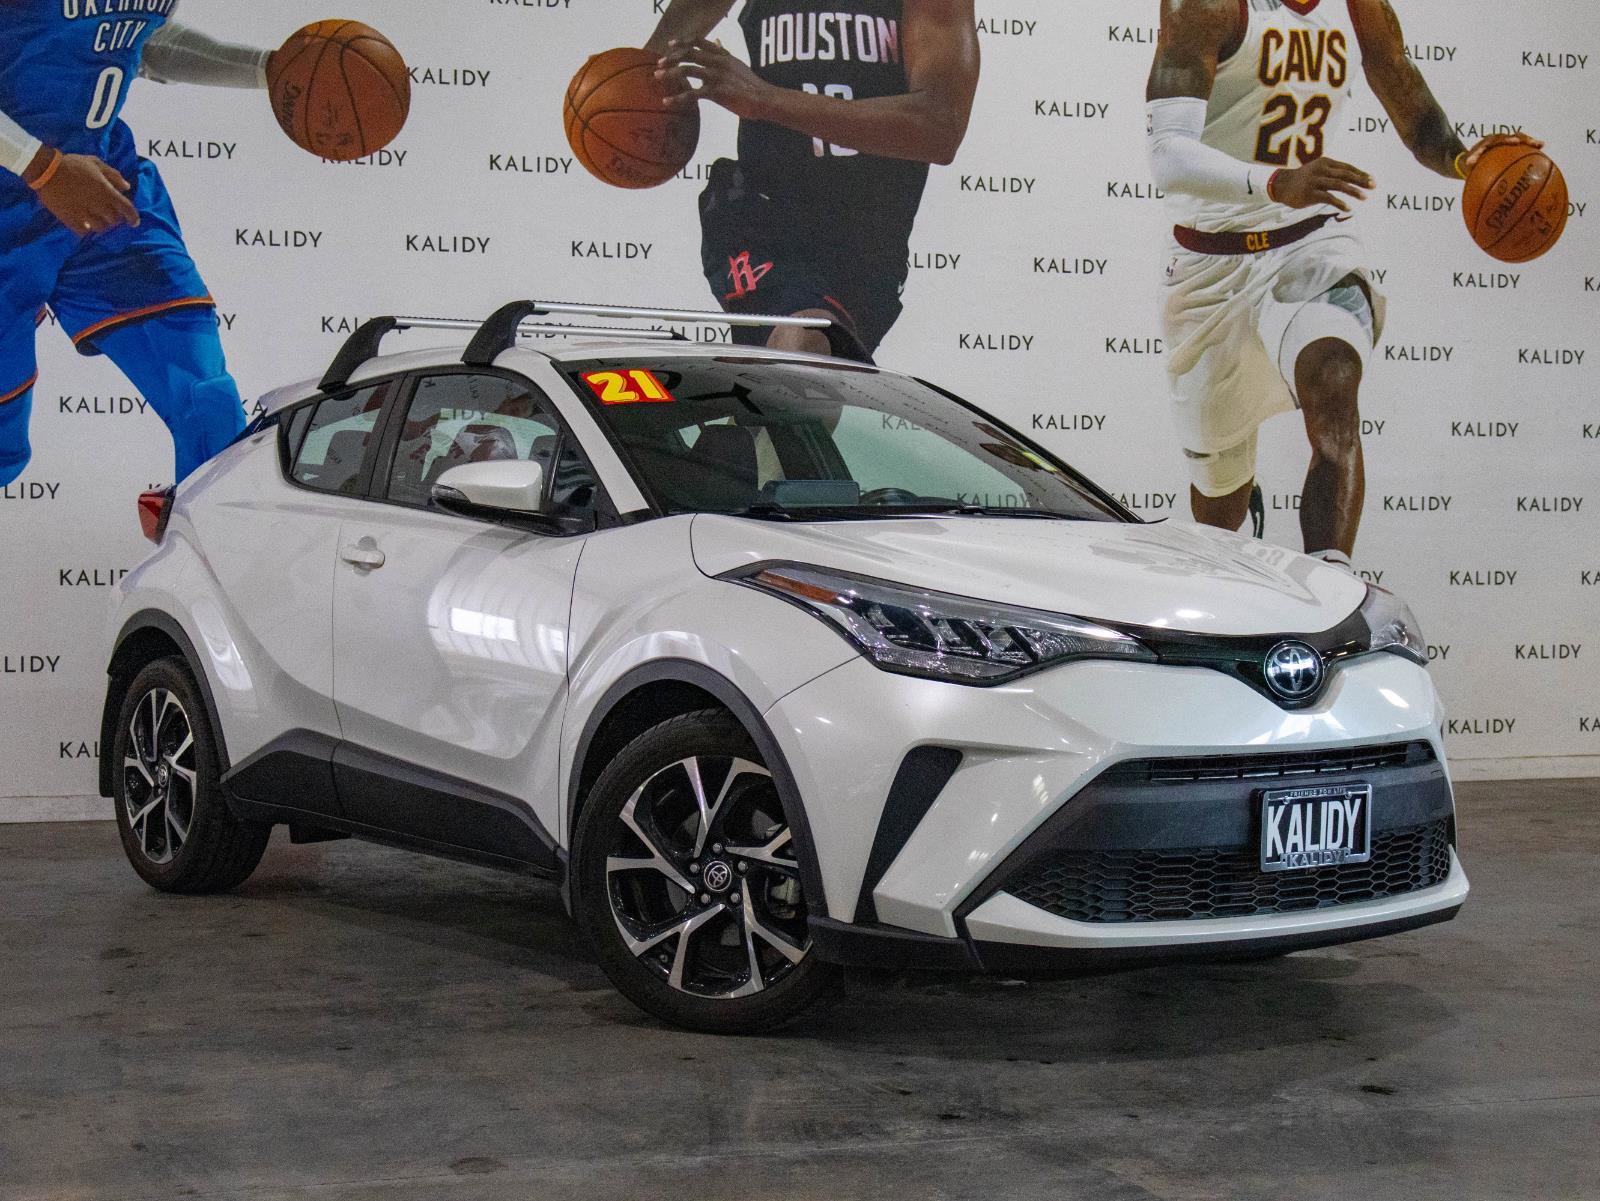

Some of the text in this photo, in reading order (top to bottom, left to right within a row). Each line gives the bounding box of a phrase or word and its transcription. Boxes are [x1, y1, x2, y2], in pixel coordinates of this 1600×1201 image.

[93, 20, 147, 52] CITY
[975, 18, 1037, 36] ALIDY
[1108, 26, 1161, 43] KALI
[760, 12, 899, 67] HOUSTON
[1256, 27, 1347, 88] CAVS
[1403, 45, 1457, 62] ALIDY
[1521, 51, 1589, 70] KALIDY
[407, 67, 491, 87] KALIDY
[1034, 99, 1109, 119] KALIDY
[1253, 91, 1332, 167] 23
[1348, 117, 1389, 133] IDY
[148, 139, 237, 160] KALIDY
[489, 154, 573, 174] KALIDY
[960, 175, 1036, 194] KALIDY
[1107, 181, 1165, 200] KALI
[1386, 194, 1456, 212] KALIDY
[235, 228, 323, 249] KALIDY
[406, 234, 490, 254] KALIDY
[1246, 230, 1270, 251] CLE
[571, 240, 653, 260] KALIDY
[908, 253, 961, 270] LIDY
[1033, 257, 1108, 275] KALIDY
[1453, 272, 1521, 289] KALIDY
[959, 333, 1034, 351] KALIDY
[1105, 337, 1163, 355] KALID
[1384, 345, 1454, 362] KALIDY
[1518, 348, 1585, 365] KALIDY
[586, 369, 667, 402] 21
[59, 396, 148, 415] KALIDY
[440, 408, 488, 421] LIDY
[882, 414, 920, 431] KAL
[1032, 413, 1106, 431] KALIDY
[1451, 421, 1519, 438] KALIDY
[2, 482, 60, 500] LIDY
[1116, 493, 1176, 510] ALIDY
[1383, 495, 1452, 512] KALIDY
[1516, 496, 1583, 513] KALIDY
[59, 568, 129, 587] KALI
[1449, 570, 1517, 586] KALIDY
[1515, 643, 1582, 660] KALIDY
[3, 655, 61, 673] LIDY
[1448, 718, 1516, 735] KALIDY
[1266, 798, 1362, 858] KALIDY
[1289, 850, 1342, 868] KALIDY
